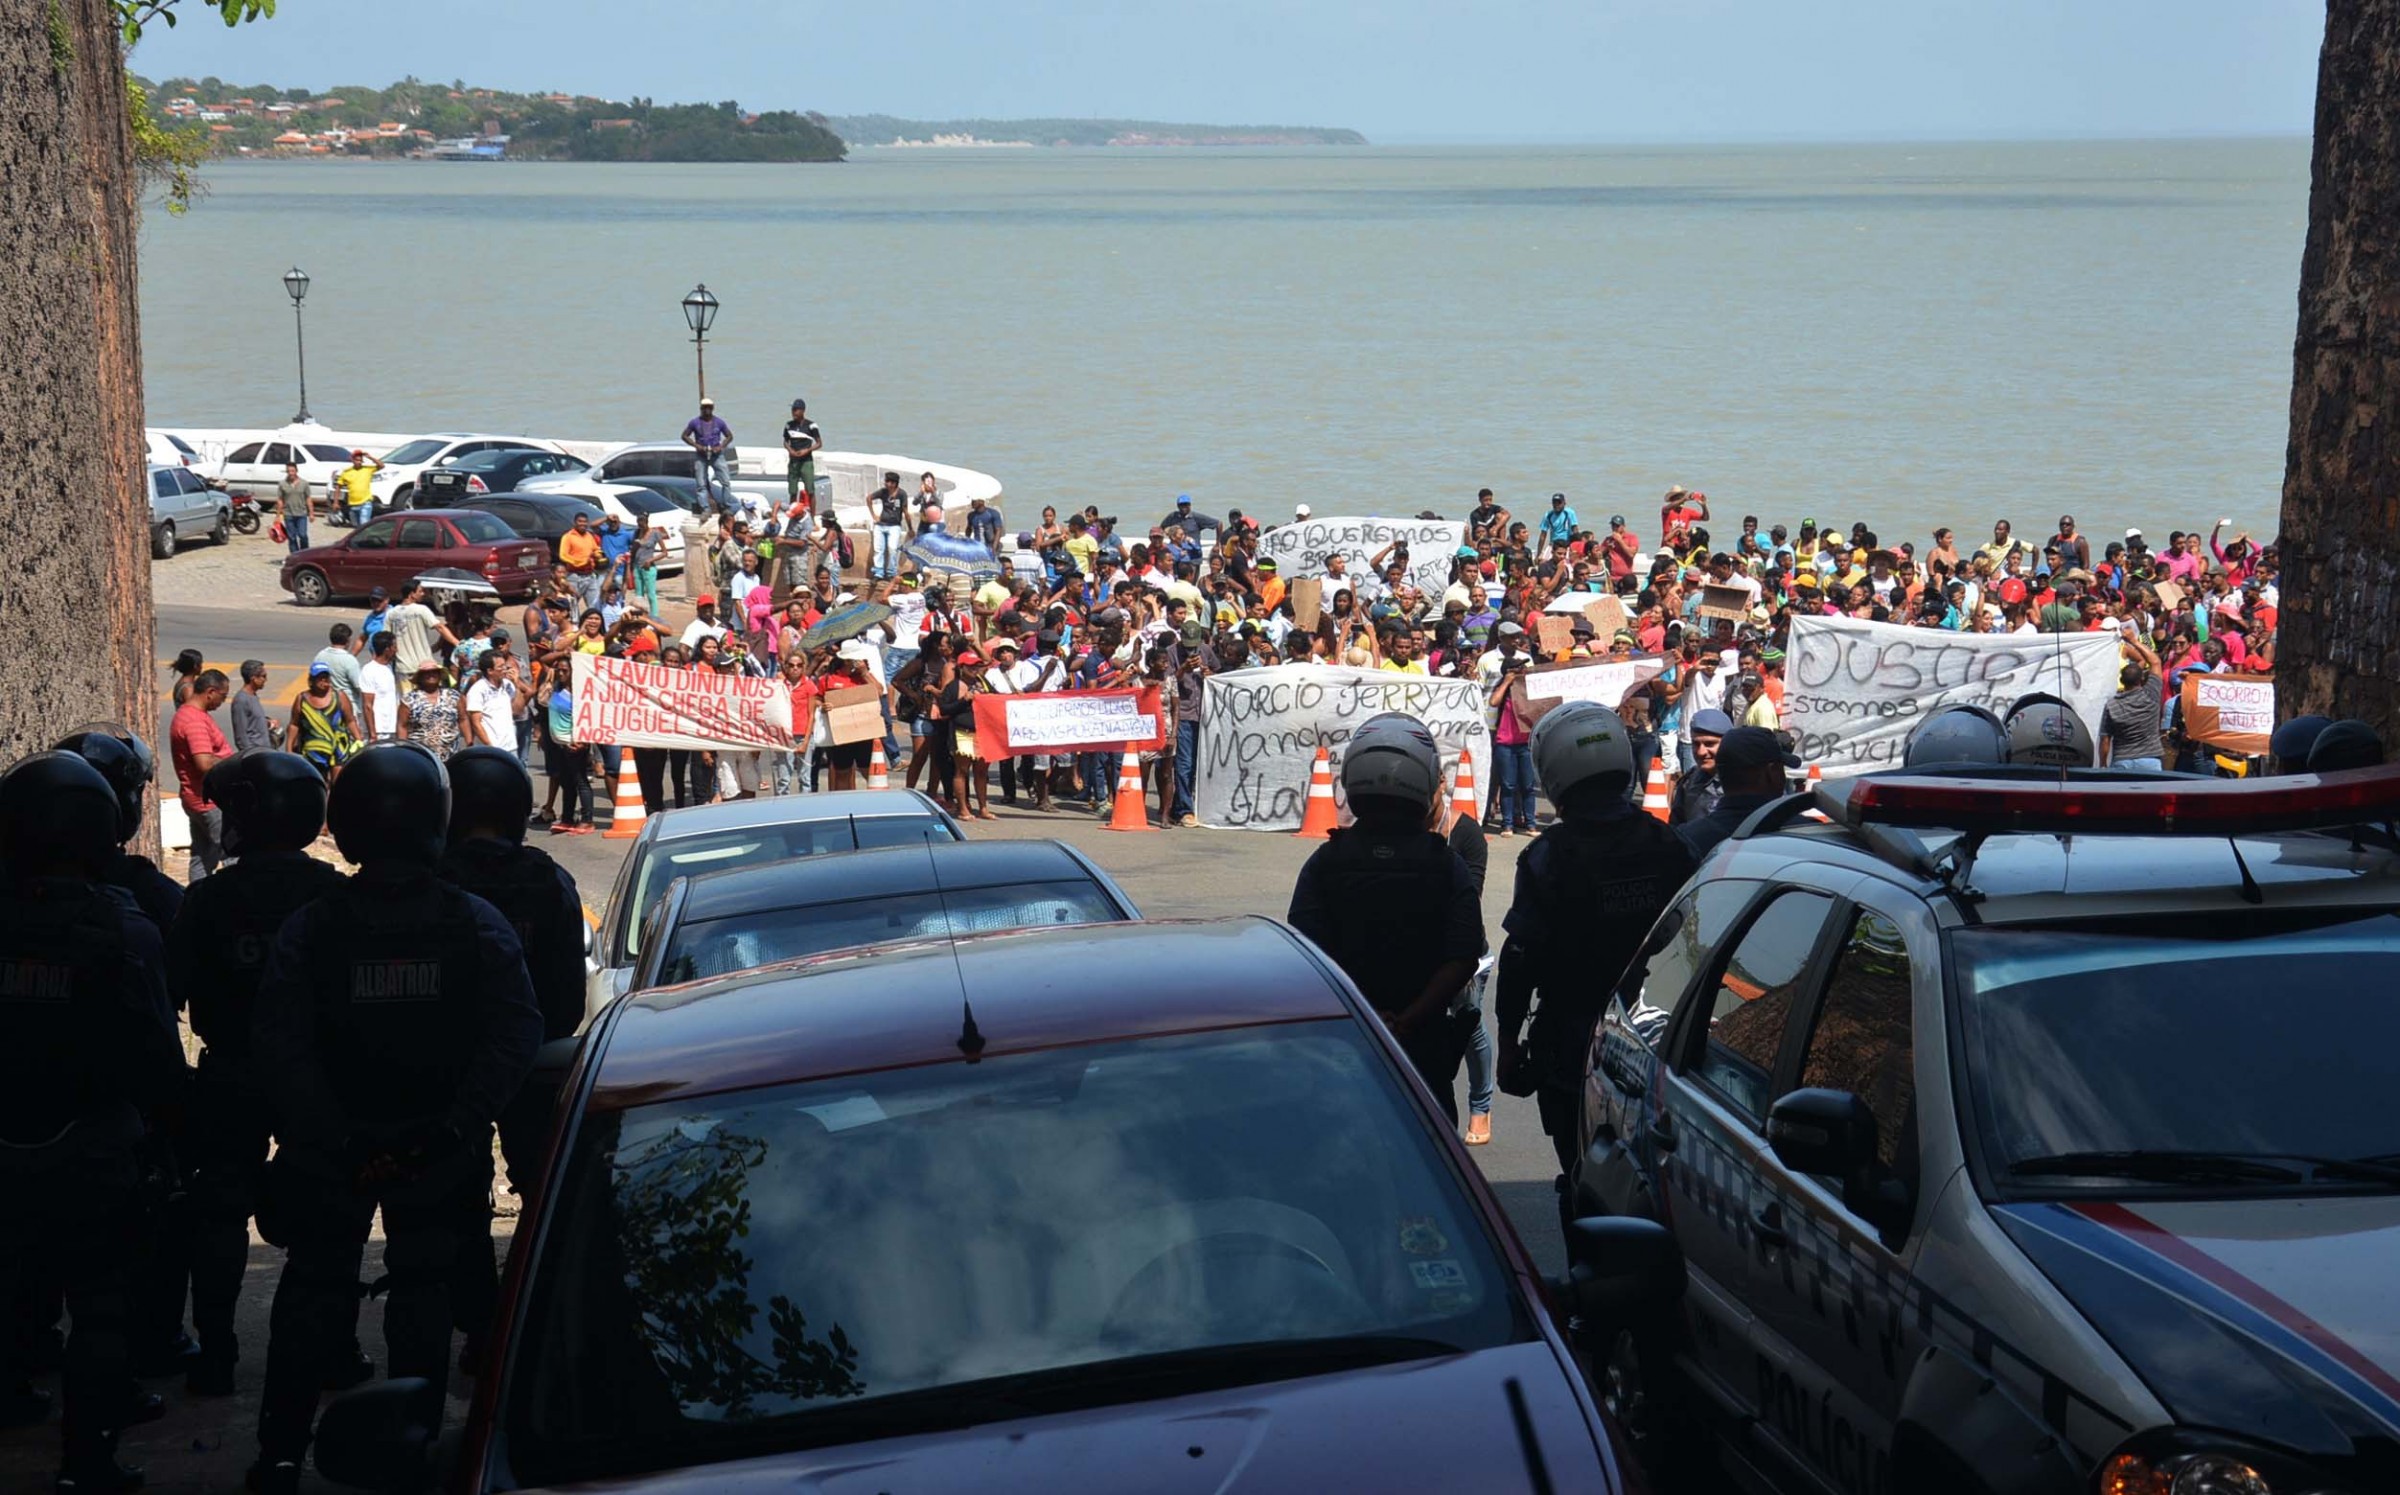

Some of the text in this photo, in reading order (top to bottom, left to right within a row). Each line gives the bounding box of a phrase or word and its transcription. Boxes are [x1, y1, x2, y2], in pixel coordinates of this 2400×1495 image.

[676, 669, 727, 695] DINO
[733, 674, 776, 699] NOS
[658, 690, 729, 721] CHEGA
[739, 698, 766, 722] DE
[579, 727, 616, 745] NOS
[355, 963, 438, 997] ALBATROZ
